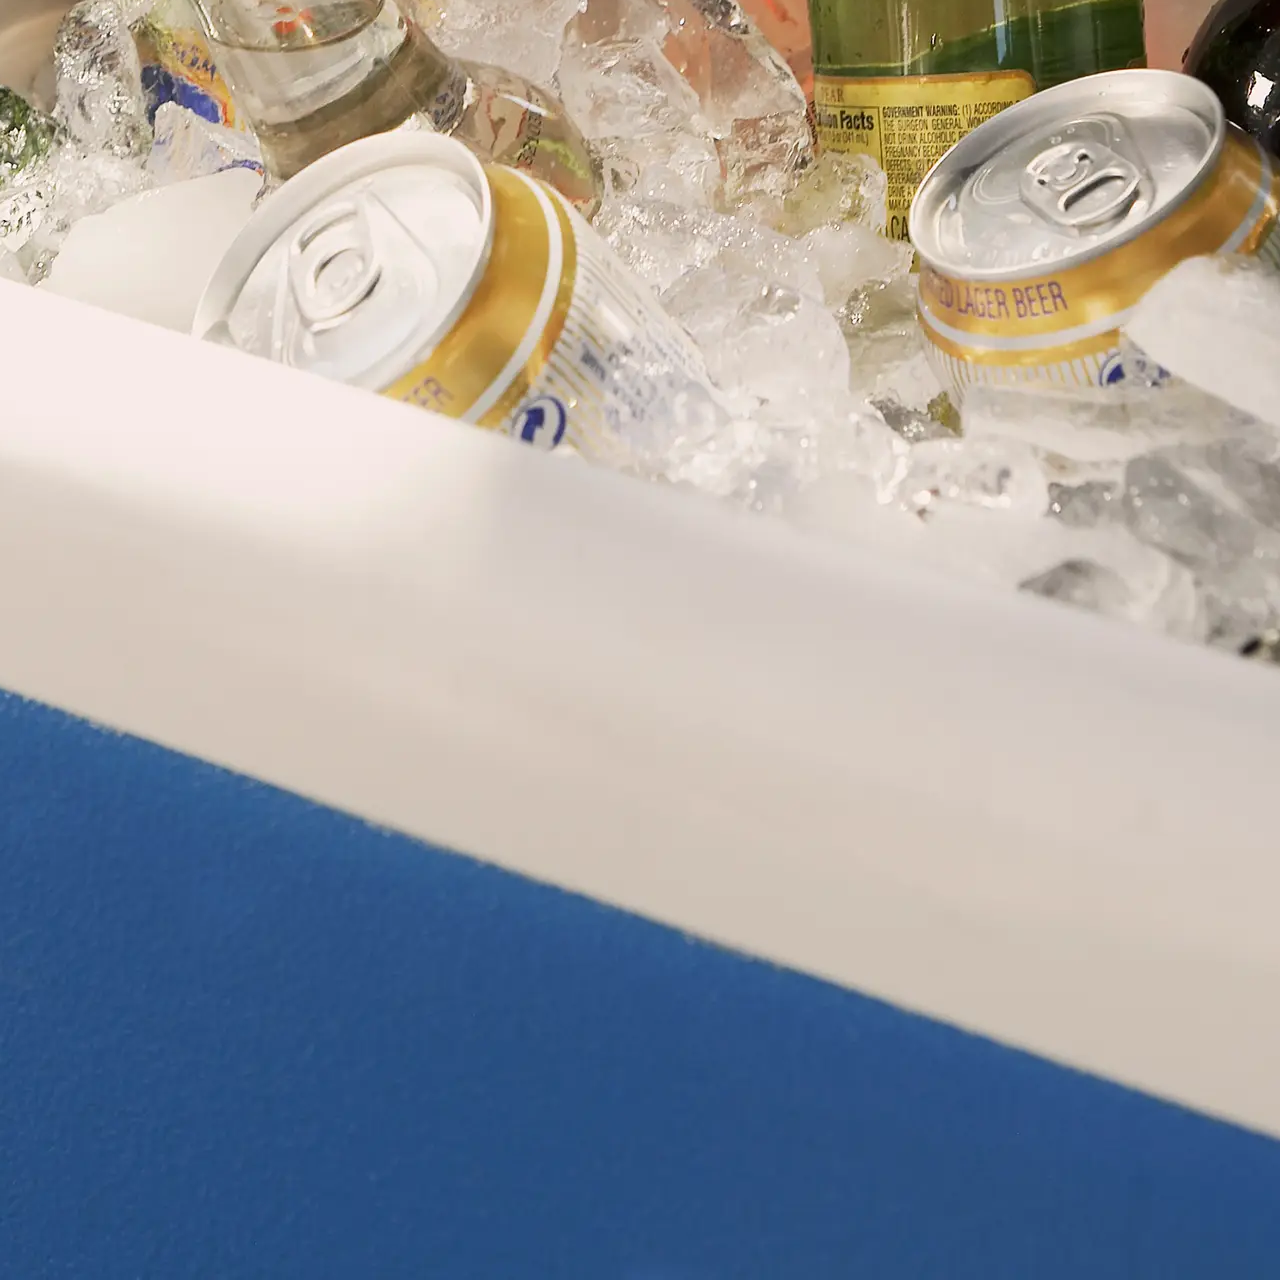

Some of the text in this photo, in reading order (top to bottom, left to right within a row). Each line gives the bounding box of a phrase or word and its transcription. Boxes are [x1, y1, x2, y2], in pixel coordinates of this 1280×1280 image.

[882, 106, 923, 118] GOVERNMENT
[926, 104, 960, 116] WARNING:
[840, 110, 874, 131] Facts
[883, 120, 895, 131] THE
[898, 119, 928, 131] SURGEON
[931, 117, 963, 130] GENERAL
[884, 133, 896, 144] NOT
[898, 132, 917, 144] DRINK
[919, 131, 956, 143] ALCOHOLIC
[885, 146, 920, 157] PREGNANCY
[957, 285, 1010, 319] LAGER
[1012, 281, 1068, 318] BEER
